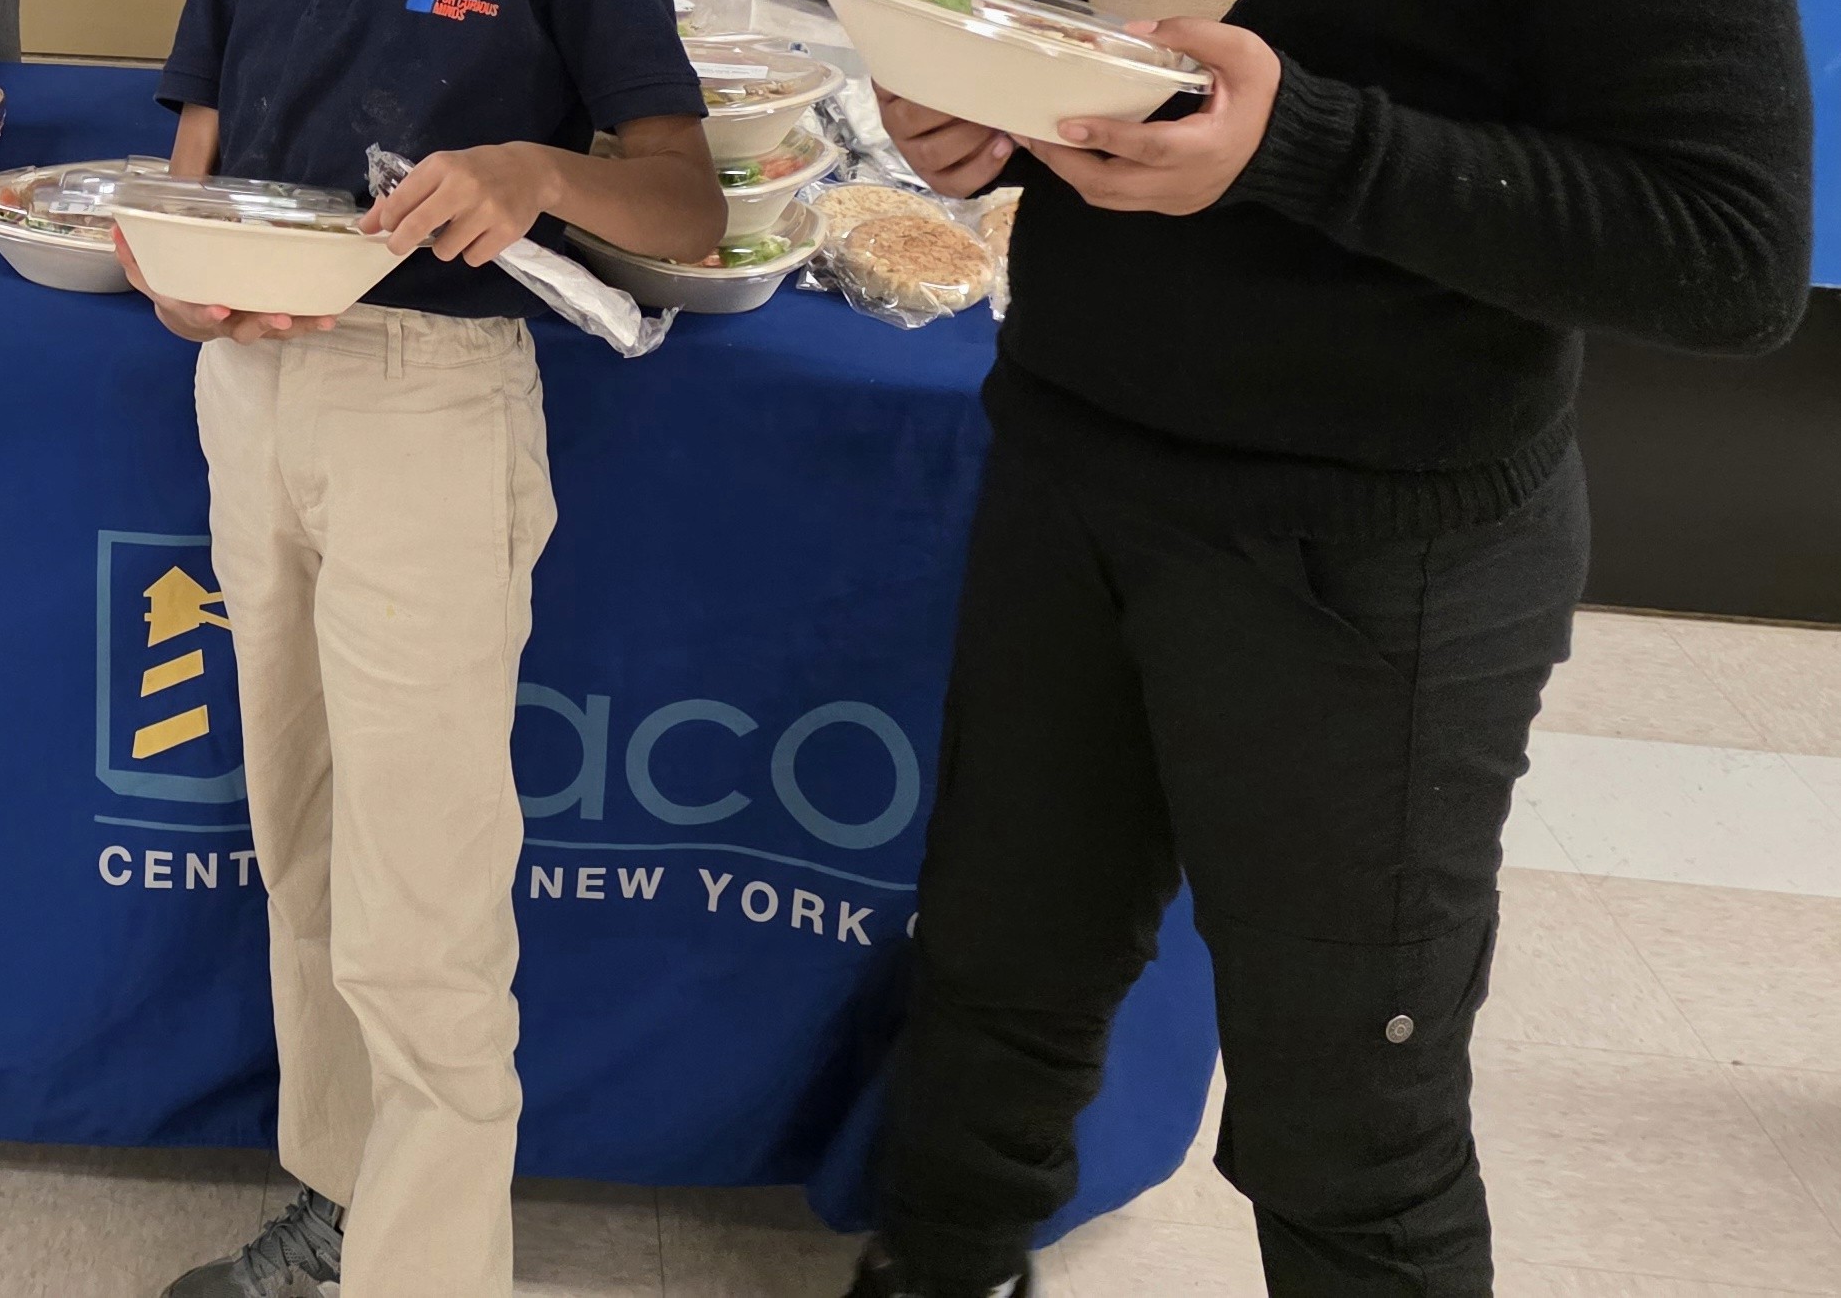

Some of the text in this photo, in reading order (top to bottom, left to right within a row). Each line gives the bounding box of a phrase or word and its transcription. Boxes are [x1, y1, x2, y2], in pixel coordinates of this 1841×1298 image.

[432, 1, 466, 21] MINDS
[98, 845, 256, 890] CENT
[530, 865, 665, 900] NEW
[698, 868, 875, 946] YORK
